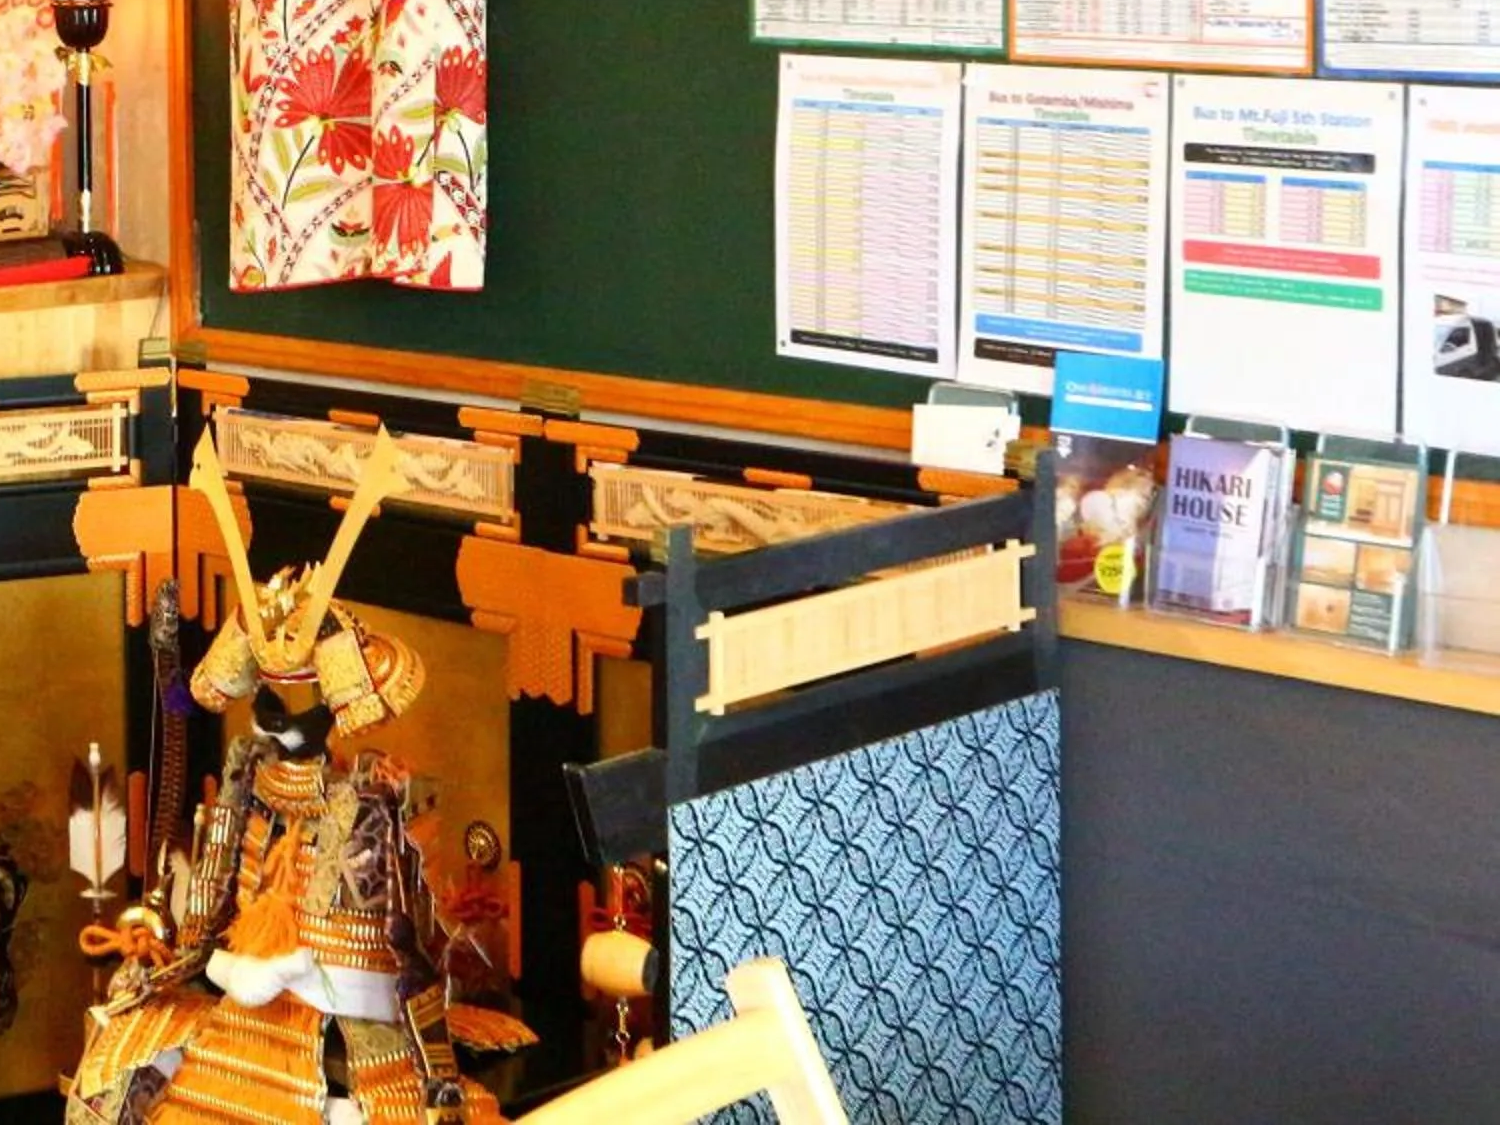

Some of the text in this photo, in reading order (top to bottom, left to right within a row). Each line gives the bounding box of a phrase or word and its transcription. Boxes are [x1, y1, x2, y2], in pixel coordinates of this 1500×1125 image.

[989, 91, 1008, 103] Bus
[1011, 93, 1022, 104] to
[1193, 106, 1373, 127] Bus to Mt.Fuji 5th Station
[1174, 466, 1252, 498] HIKARI
[1171, 493, 1250, 527] HOUSE
